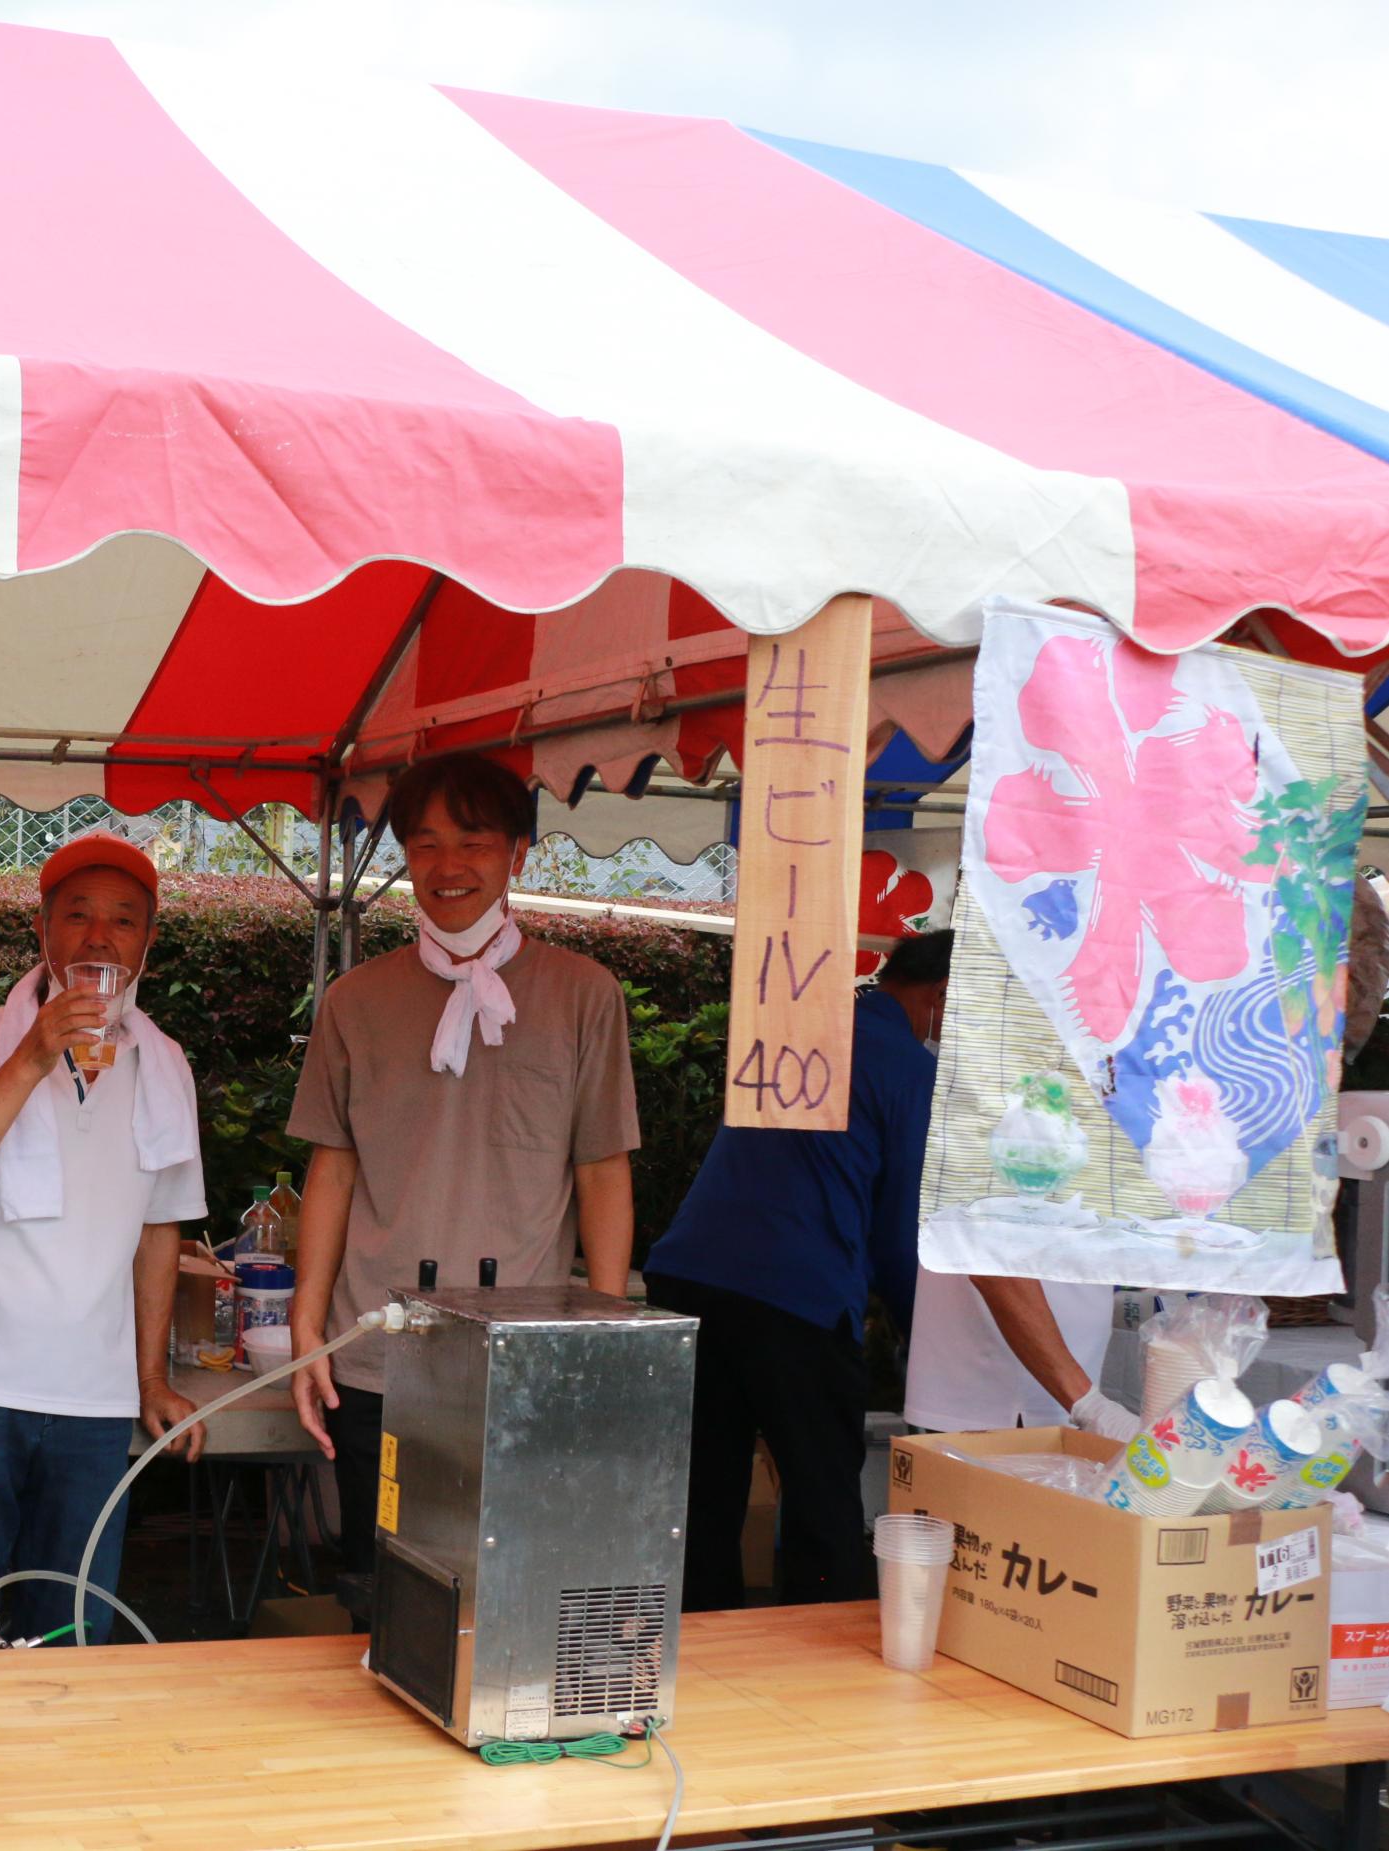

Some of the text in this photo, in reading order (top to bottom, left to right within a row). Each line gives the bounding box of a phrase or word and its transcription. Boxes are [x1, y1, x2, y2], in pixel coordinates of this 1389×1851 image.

[754, 644, 851, 1005] 生ビール
[732, 1039, 832, 1112] 400
[1001, 1541, 1098, 1598] カレー
[1245, 1586, 1315, 1621] カレー
[1146, 1708, 1194, 1726] MG172
